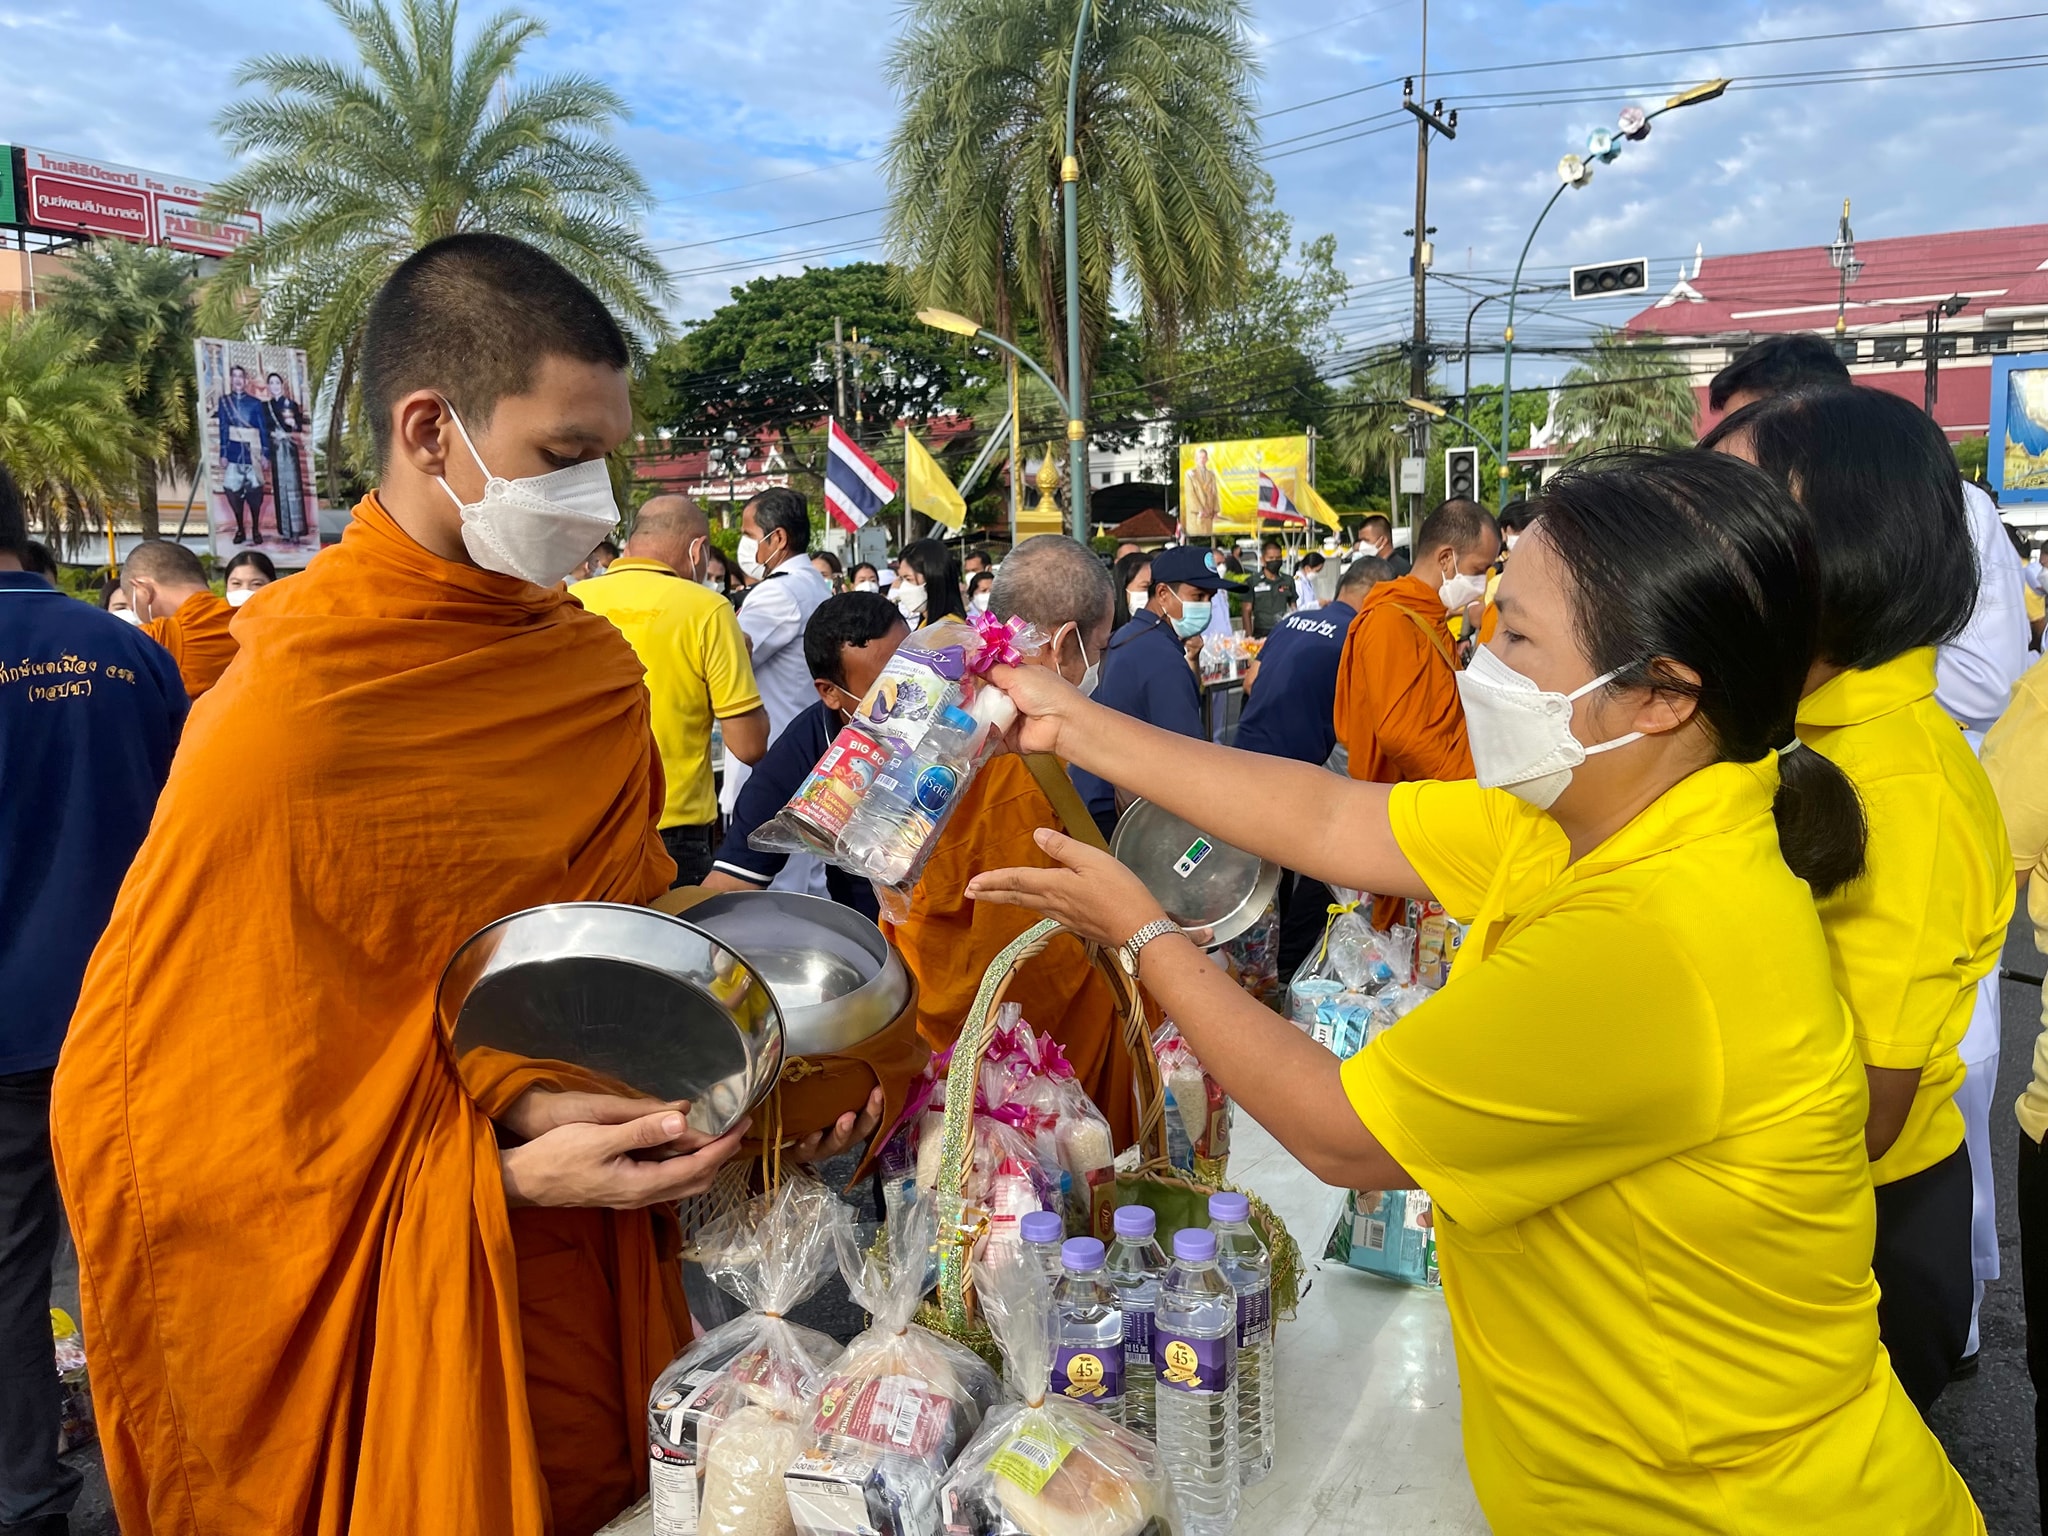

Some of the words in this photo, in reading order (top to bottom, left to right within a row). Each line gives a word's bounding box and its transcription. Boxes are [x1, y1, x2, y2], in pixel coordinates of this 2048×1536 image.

[1286, 617, 1337, 638] ทสปช.
[849, 739, 870, 754] BIG
[871, 749, 885, 766] BO
[1172, 1349, 1189, 1366] 45
[1076, 1363, 1093, 1377] 45
